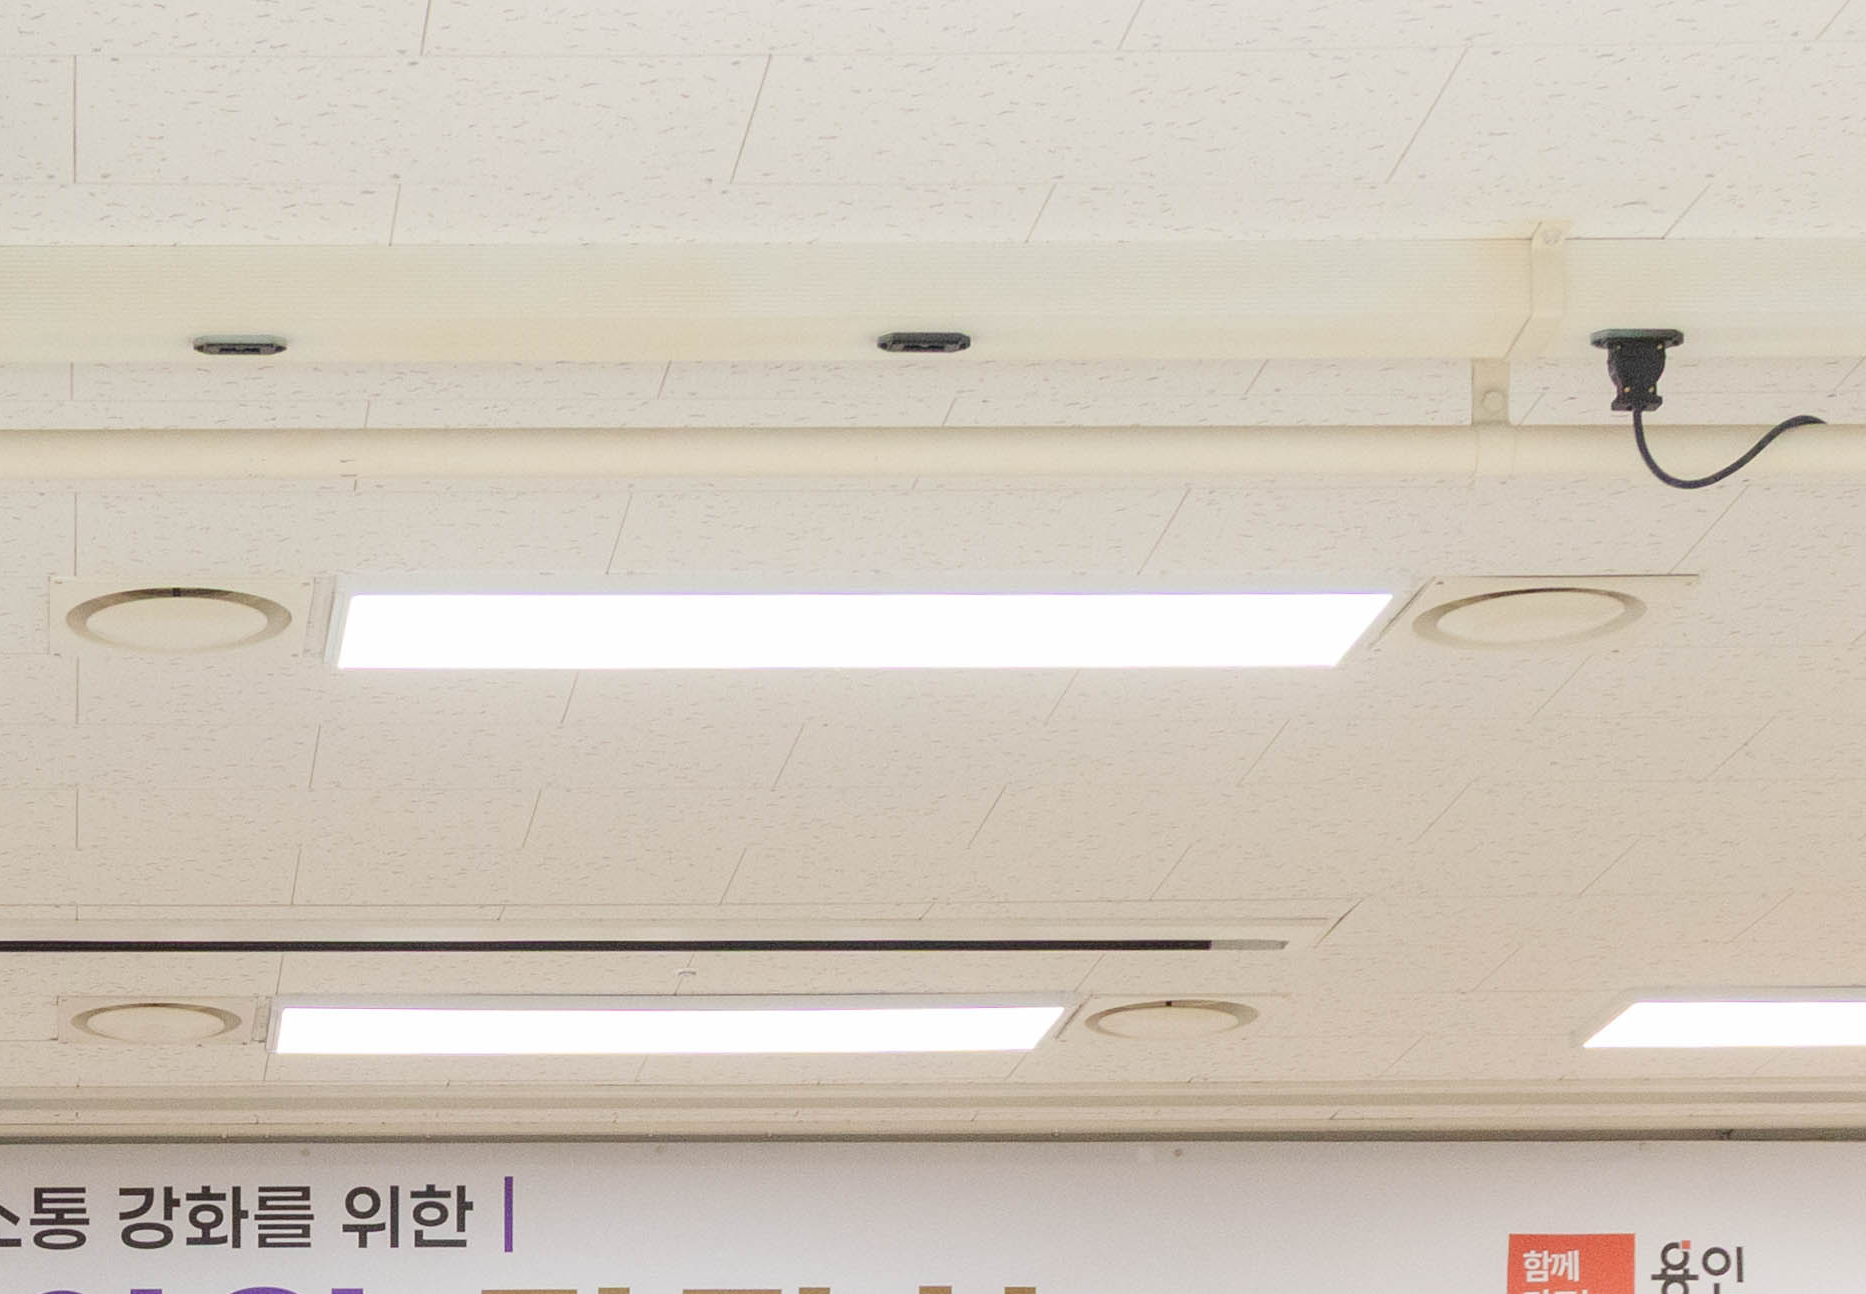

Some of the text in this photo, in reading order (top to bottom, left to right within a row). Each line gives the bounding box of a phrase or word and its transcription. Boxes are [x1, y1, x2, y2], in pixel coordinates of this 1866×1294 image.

[119, 1186, 316, 1251] 강화를
[343, 1184, 475, 1250] 위한
[1523, 1249, 1581, 1283] 함께
